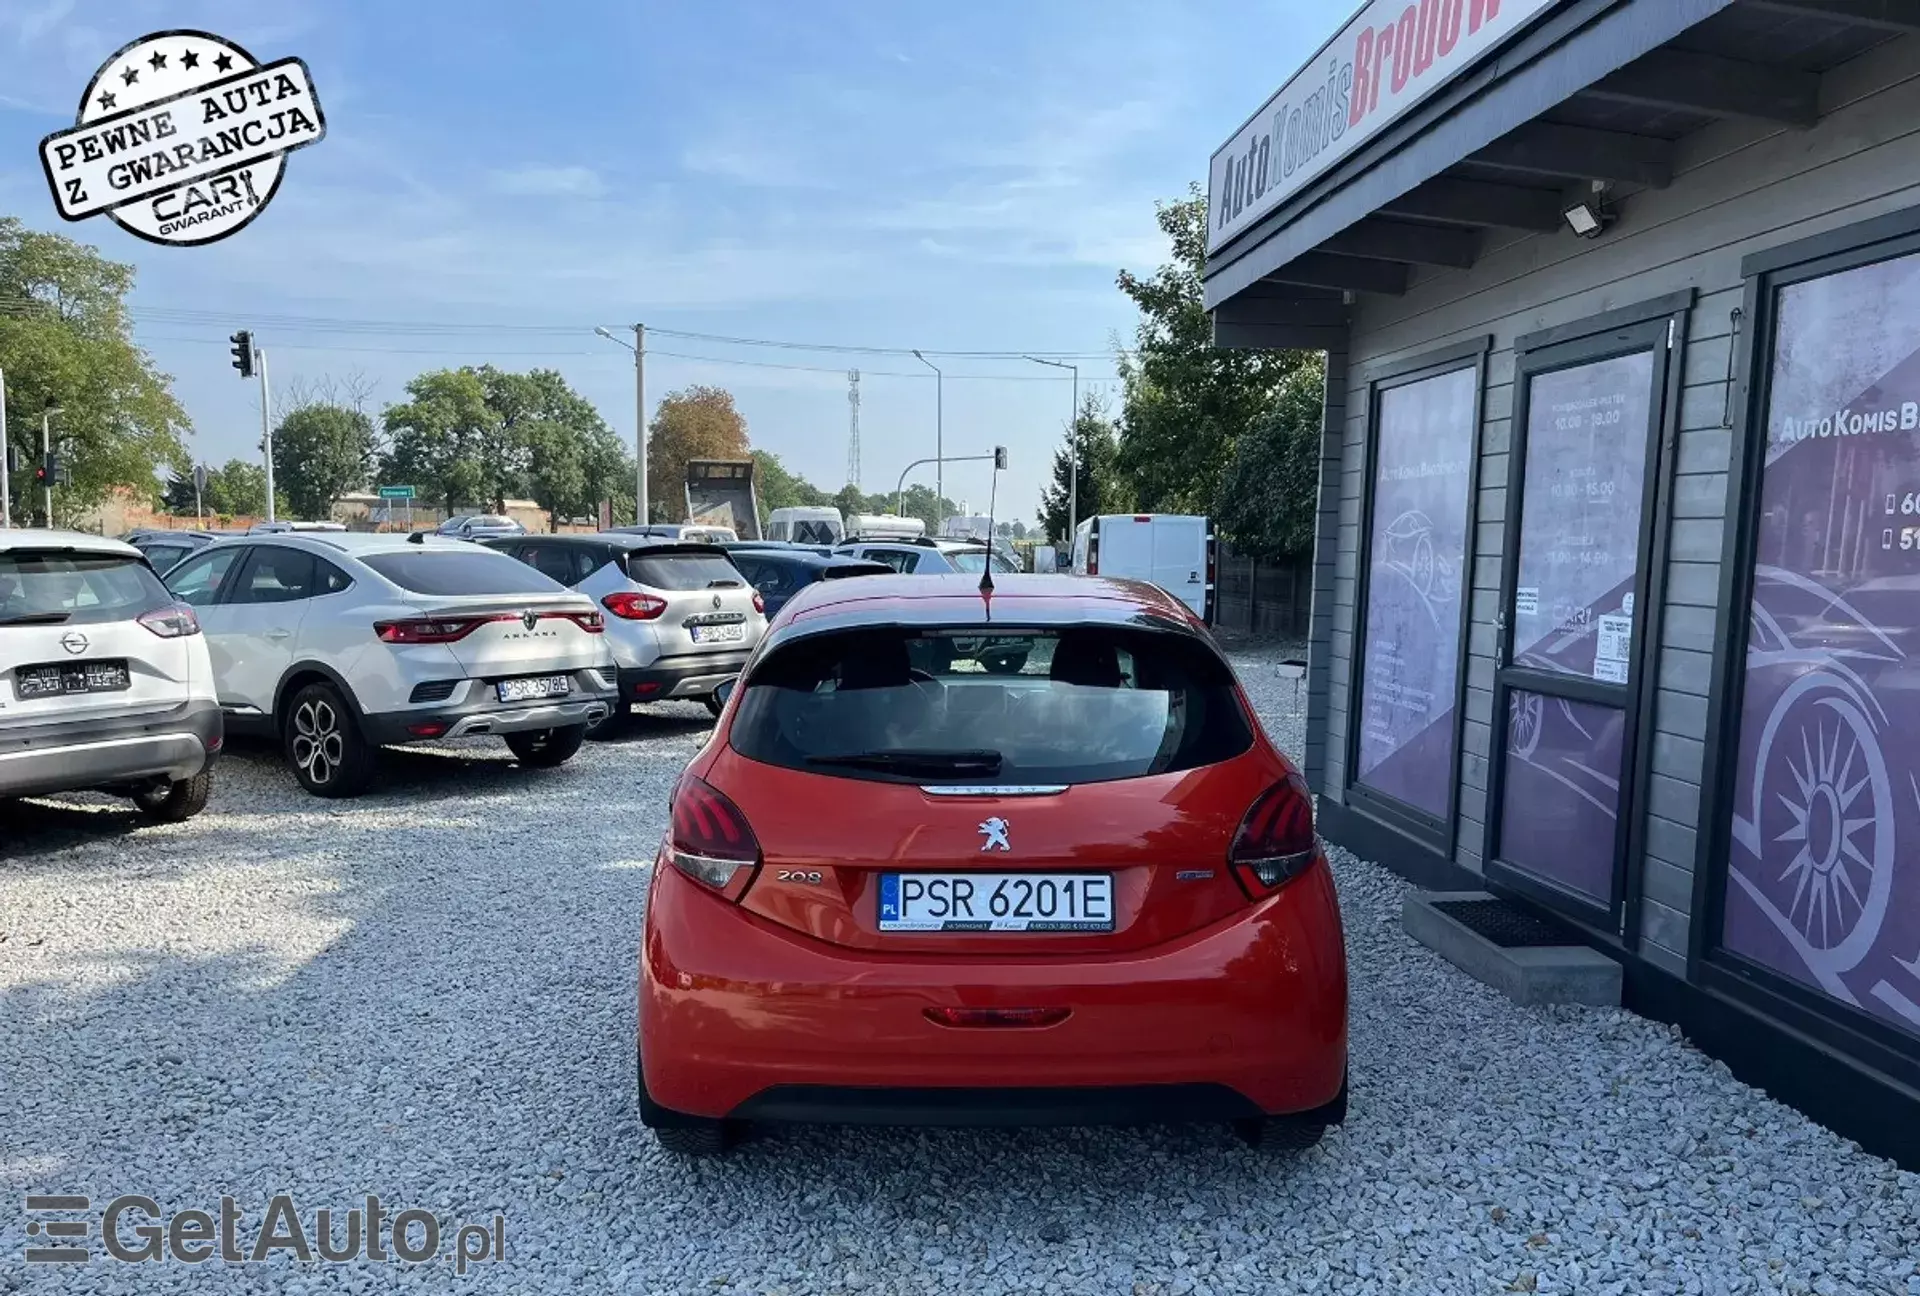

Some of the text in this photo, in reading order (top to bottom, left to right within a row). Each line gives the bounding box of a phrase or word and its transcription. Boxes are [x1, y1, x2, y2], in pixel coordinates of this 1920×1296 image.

[506, 679, 530, 697] PSR
[777, 870, 822, 883] 208
[902, 879, 1106, 917] PSR 6201E
[883, 904, 897, 915] PL
